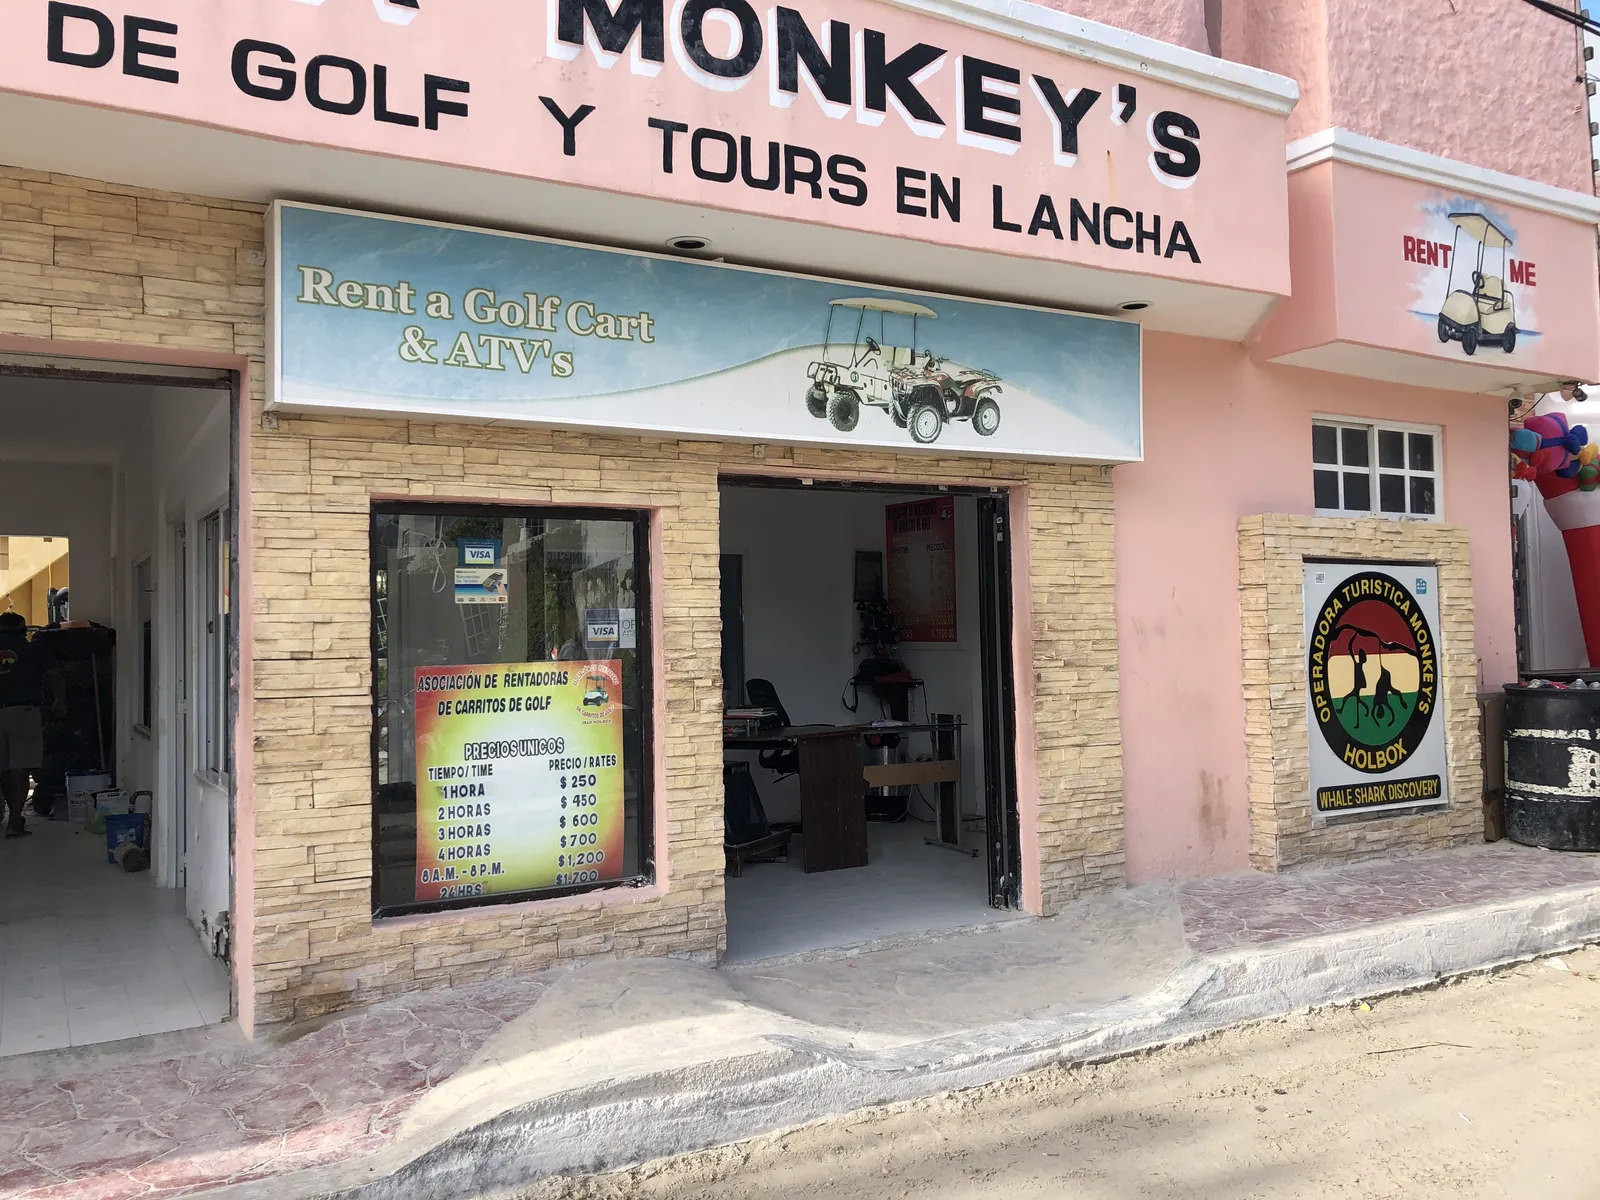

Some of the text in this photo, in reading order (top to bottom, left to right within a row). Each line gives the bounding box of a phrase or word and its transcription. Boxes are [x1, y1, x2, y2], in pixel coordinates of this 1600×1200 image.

[553, 0, 1202, 182] MONKEY'S
[47, 1, 1202, 264] DE GOLF Y TOURS EN LANCHA
[1403, 234, 1536, 287] RENT ME
[297, 264, 655, 343] Rent a Golf Cart
[399, 325, 574, 378] & ATV's
[470, 550, 490, 558] VISA
[592, 627, 614, 636] VISA
[1312, 578, 1434, 722] OPERADORA TURISTICA MONKEY'S
[418, 670, 568, 692] ASOCIACIÓN DE RENTADORAS
[438, 696, 552, 716] DE CARRITOS DE GOLF
[464, 737, 564, 760] PRECIOS UNICOS
[1344, 738, 1408, 769] HOLBOX
[472, 764, 493, 776] TIME
[549, 758, 581, 771] PRECIO
[590, 755, 616, 768] RATES
[450, 783, 485, 798] HORA
[560, 774, 596, 789] $ 250
[560, 794, 596, 809] $ 450
[1319, 778, 1438, 808] WHALE SHARK DISCOVERY
[438, 803, 490, 820] 2 HORAS
[560, 813, 598, 829] $ 600
[438, 824, 490, 840] 3 HORAS
[438, 844, 490, 860] 4 HORAS
[422, 870, 428, 882] 8
[432, 867, 458, 882] A.M.
[470, 865, 476, 876] 8
[480, 862, 505, 876] P.M.
